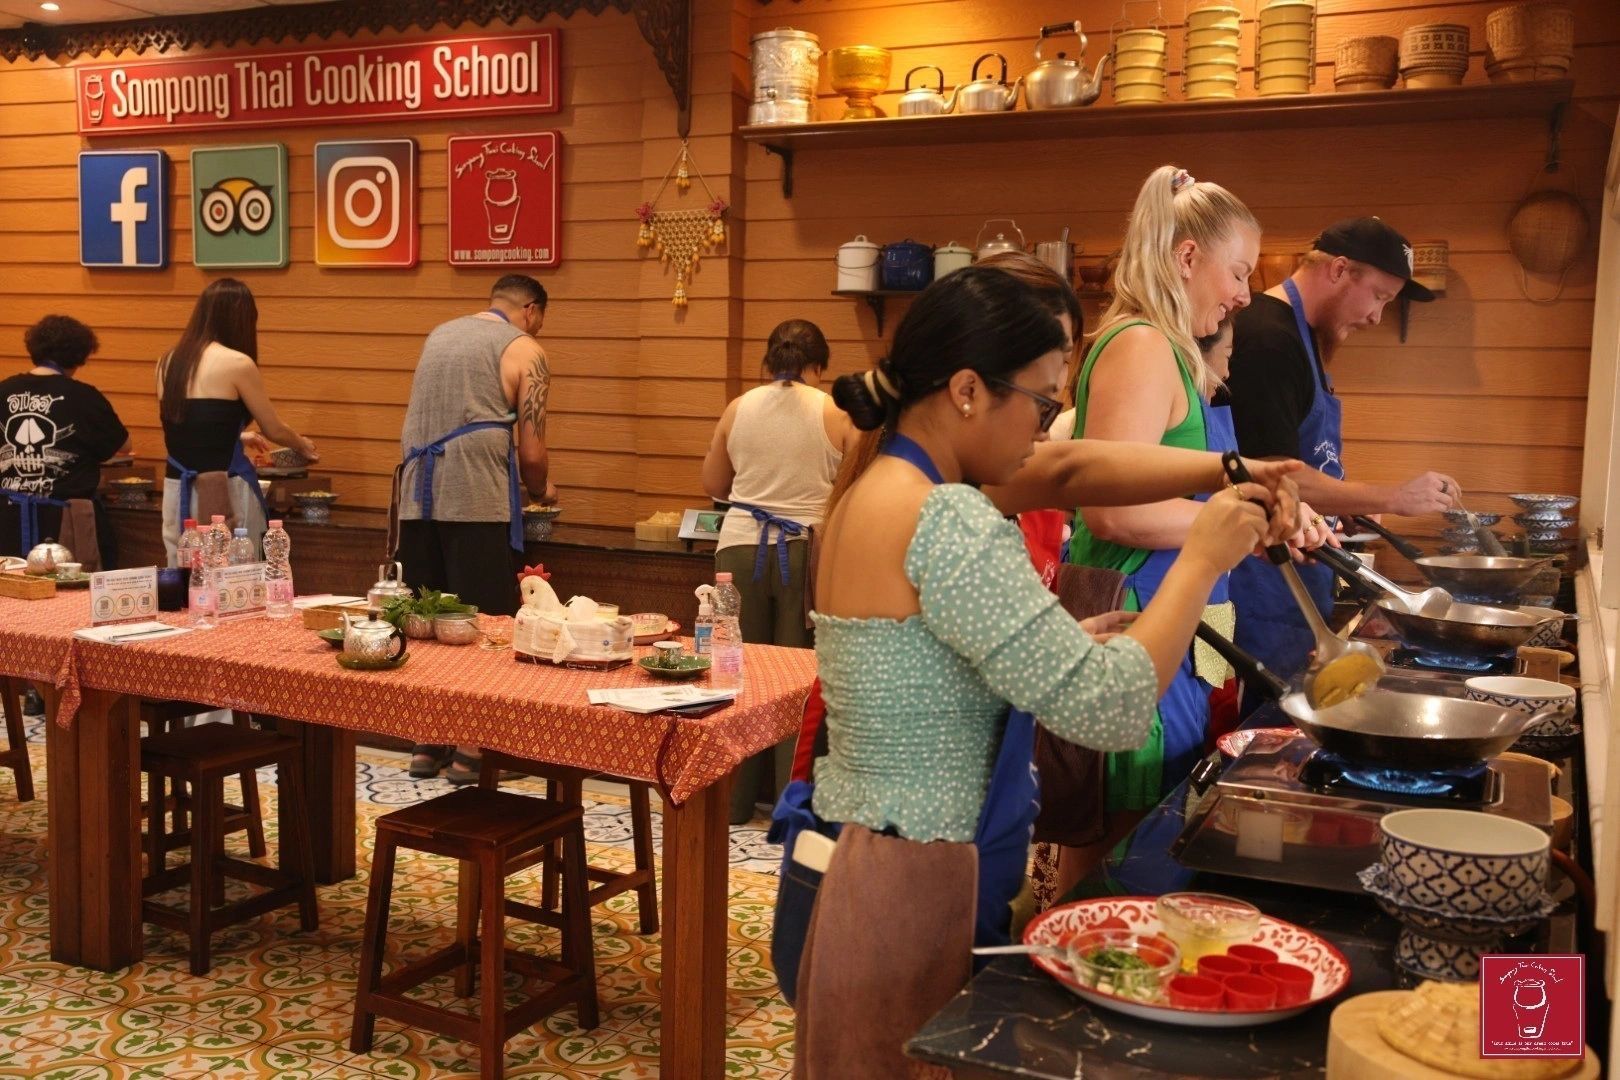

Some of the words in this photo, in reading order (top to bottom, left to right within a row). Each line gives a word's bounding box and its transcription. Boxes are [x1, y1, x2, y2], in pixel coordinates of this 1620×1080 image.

[111, 69, 229, 122] Sompong
[234, 57, 293, 110] Thai
[304, 55, 420, 108] Cooking
[432, 41, 537, 98] School
